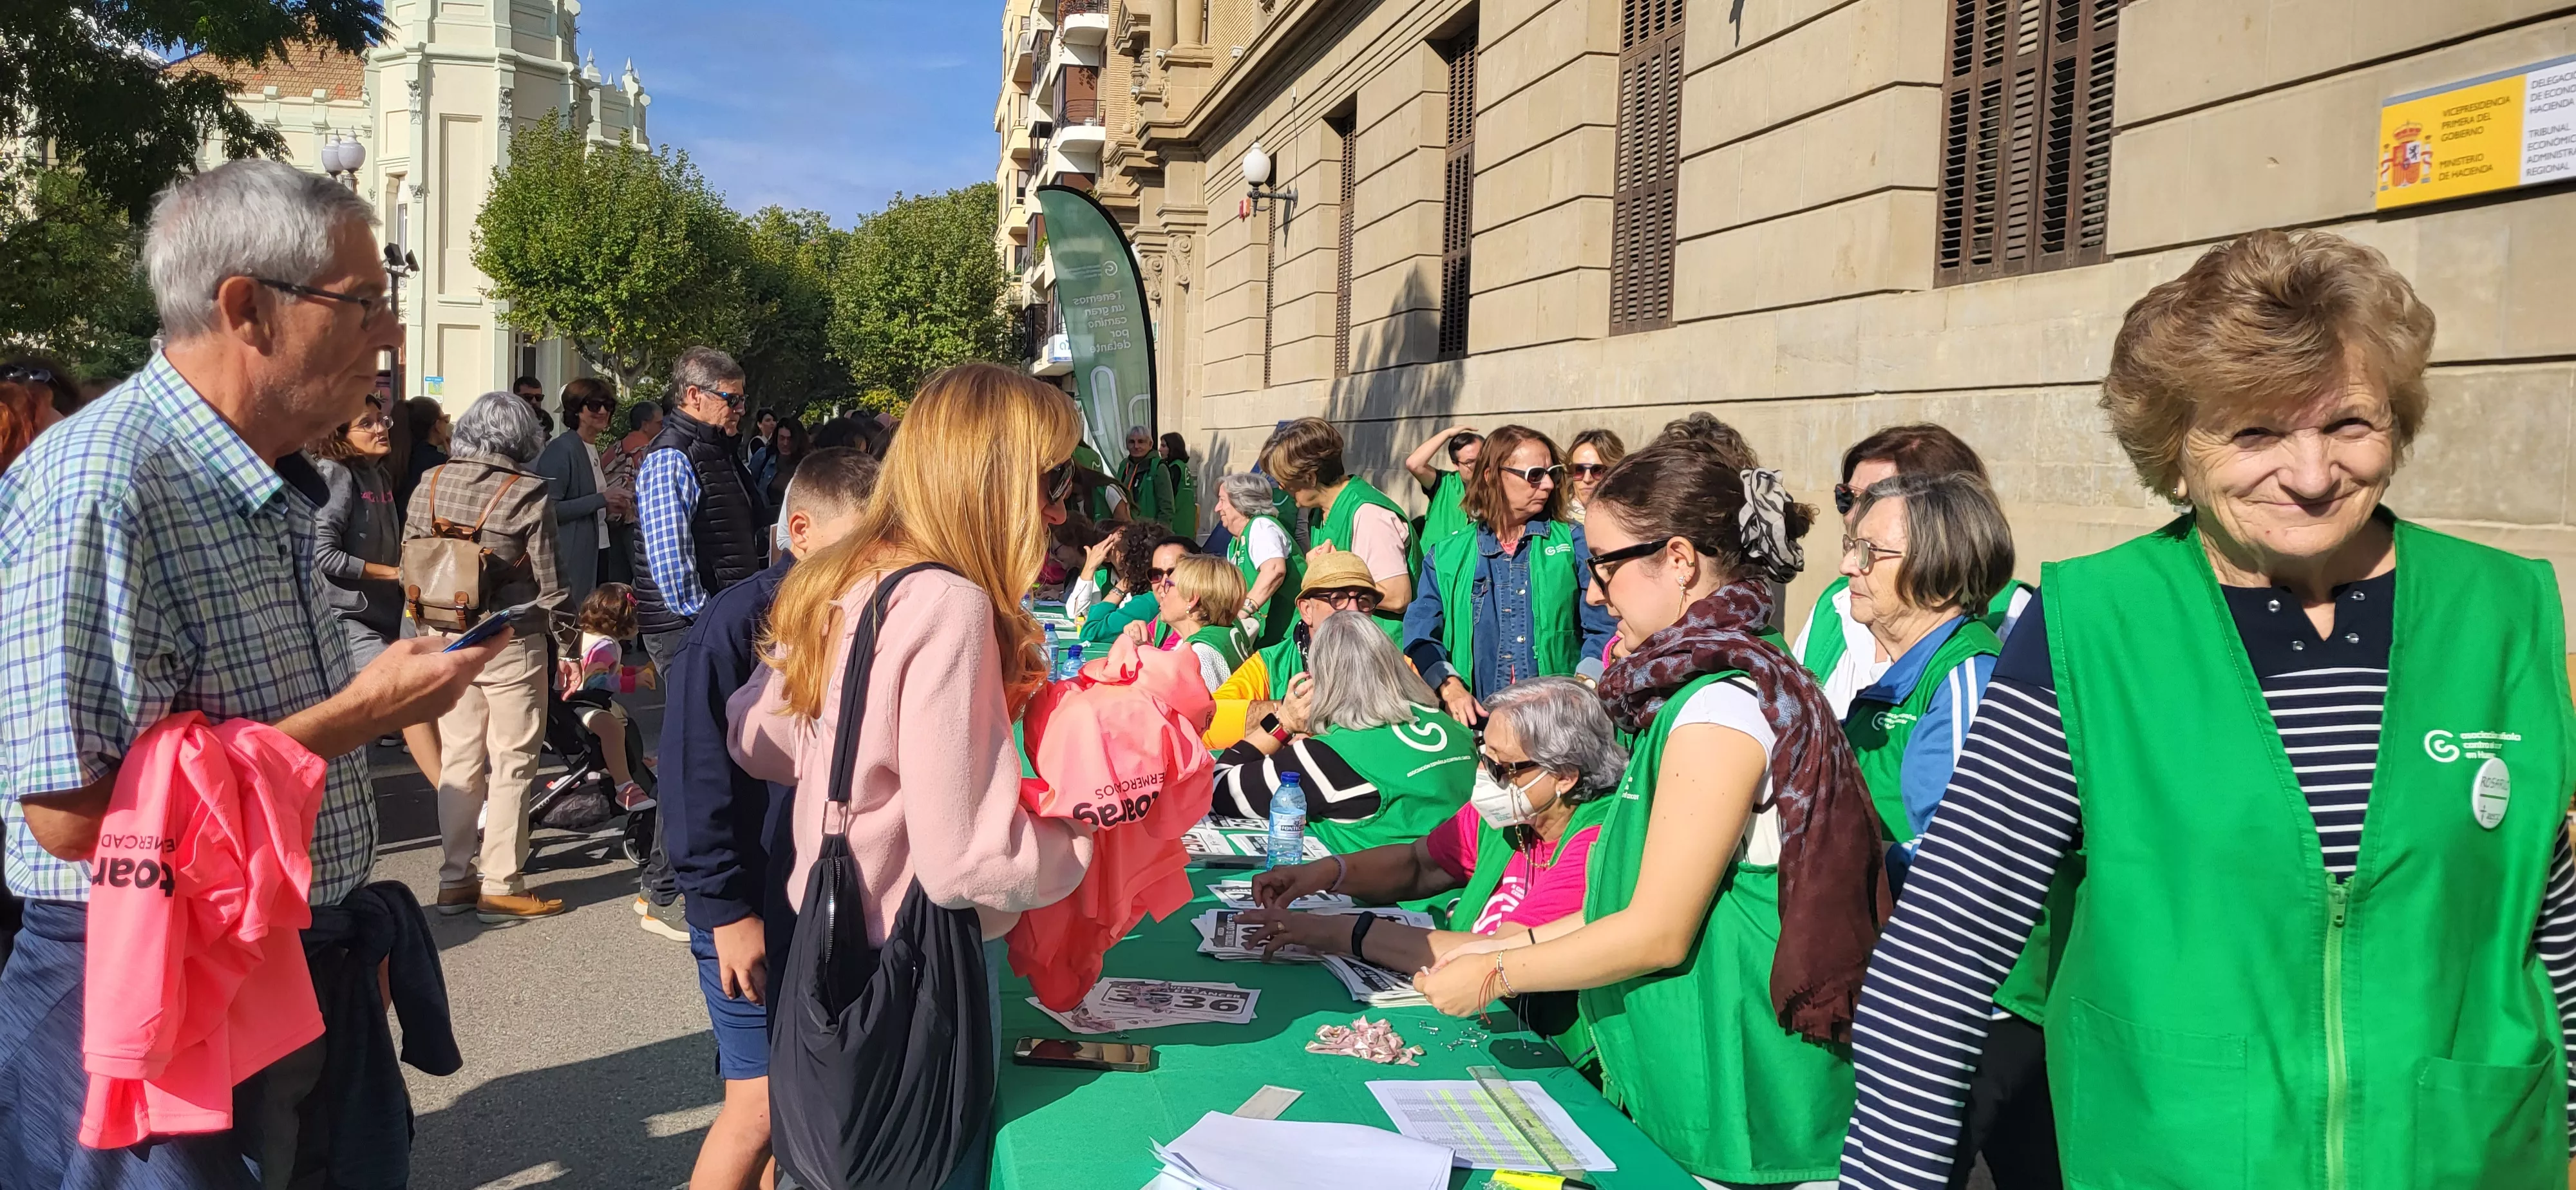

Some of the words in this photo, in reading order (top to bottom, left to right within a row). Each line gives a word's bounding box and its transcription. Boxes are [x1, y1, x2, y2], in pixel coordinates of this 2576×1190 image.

[2530, 92, 2543, 102] DE
[2443, 95, 2510, 117] VICEPRESIDENCIA
[2530, 98, 2574, 115] HACIENDA
[2441, 116, 2474, 129] PRIMERA
[2476, 112, 2492, 122] DEL
[2441, 126, 2485, 142] GOBIERNO
[2528, 122, 2571, 138] TRIBUNAL
[2439, 153, 2485, 169] MINISTERIO
[2438, 172, 2450, 181] DE
[2452, 164, 2494, 178] HACIENDA
[2526, 162, 2570, 177] REGIONAL
